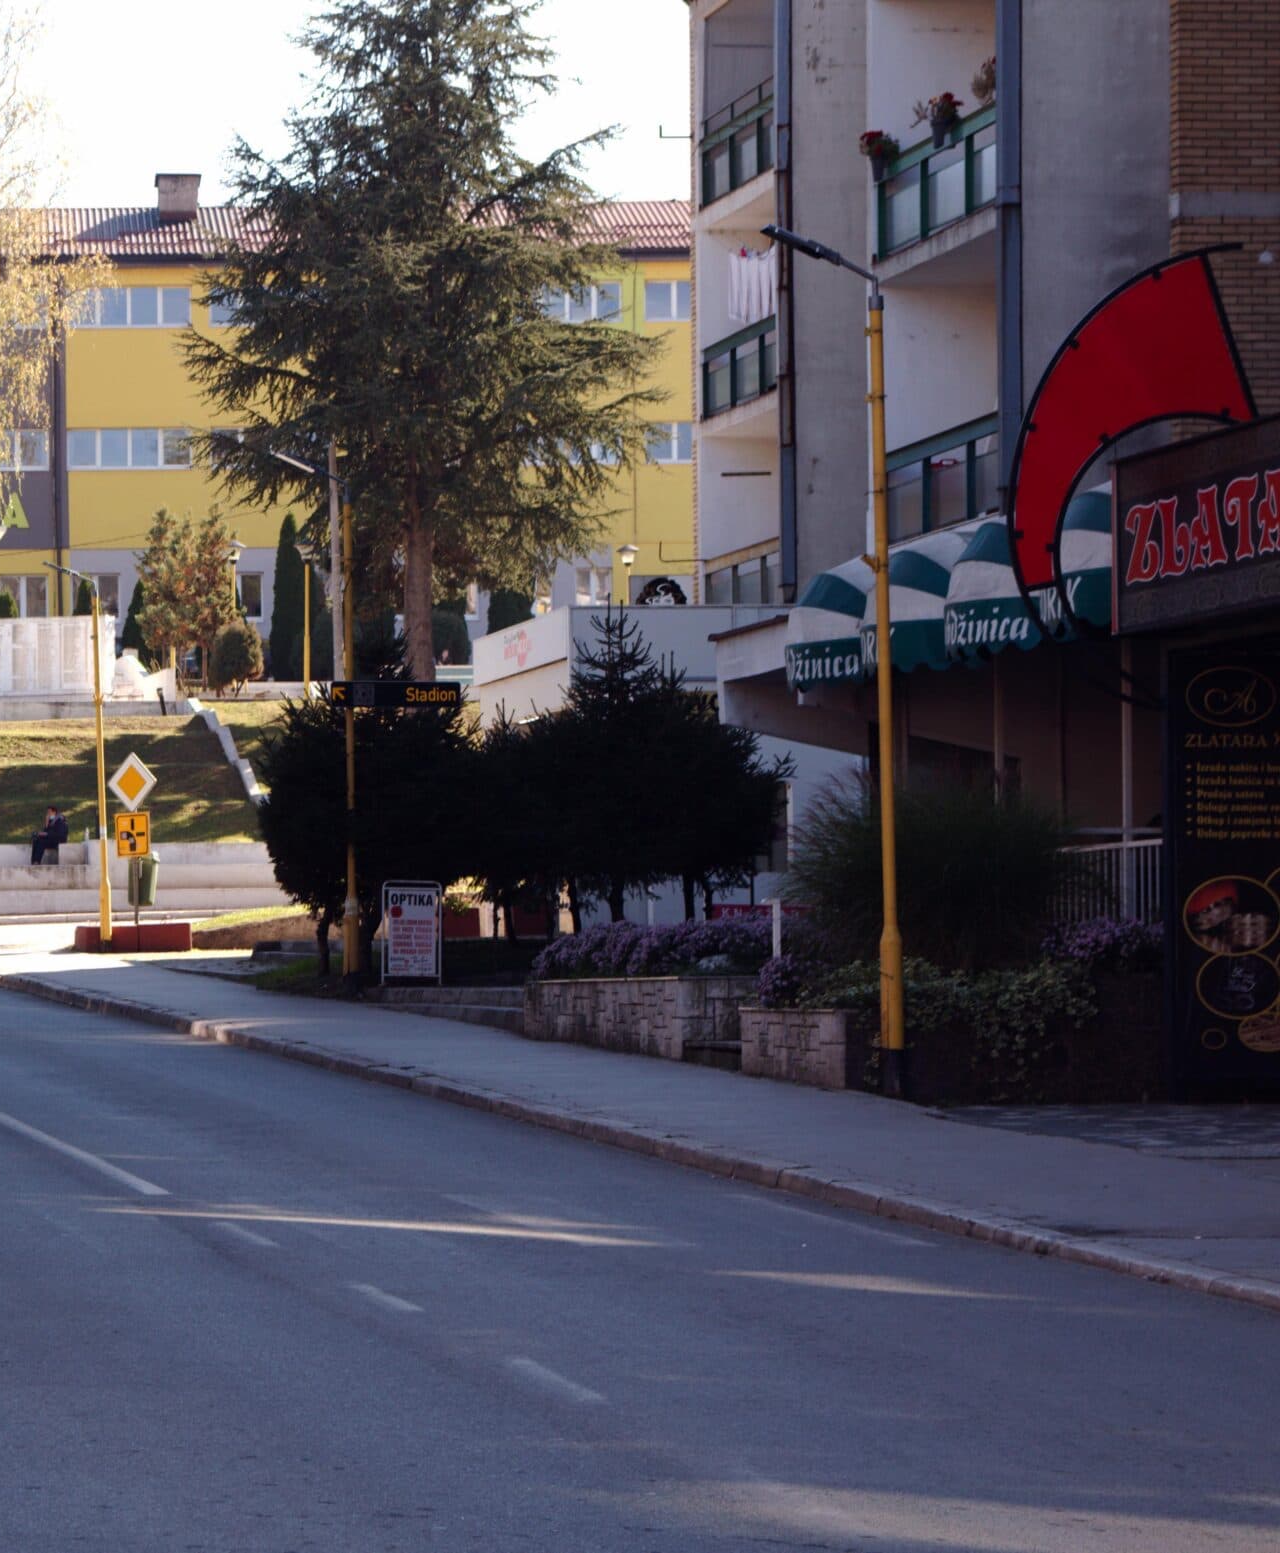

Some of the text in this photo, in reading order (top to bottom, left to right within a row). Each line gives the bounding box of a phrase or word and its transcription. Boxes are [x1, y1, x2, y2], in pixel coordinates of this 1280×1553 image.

[1124, 467, 1280, 587] ZLATA
[405, 686, 457, 703] Stadion
[1183, 732, 1269, 749] ZLATARA
[390, 893, 433, 906] OPTIKA
